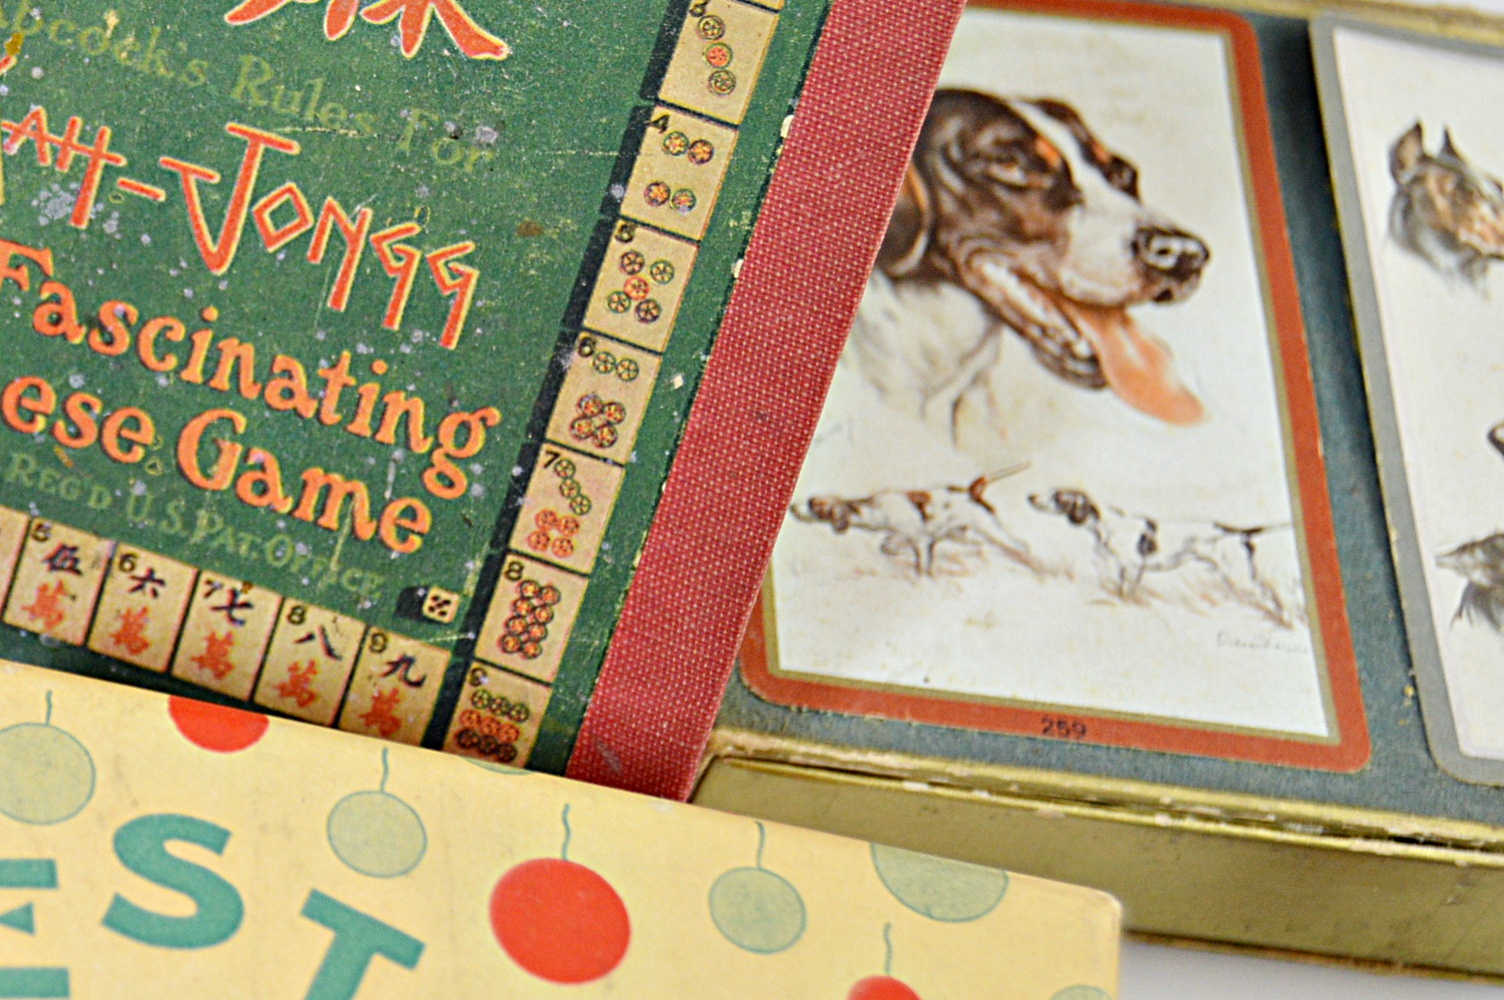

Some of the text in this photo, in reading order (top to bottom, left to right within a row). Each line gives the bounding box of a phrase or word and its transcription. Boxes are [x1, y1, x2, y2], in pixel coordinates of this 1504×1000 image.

[231, 54, 380, 140] Rules
[396, 107, 494, 174] For
[646, 114, 669, 134] 4
[577, 335, 596, 358] 6
[540, 451, 561, 469] 7
[177, 407, 434, 555] Game
[31, 523, 51, 542] 5
[117, 553, 136, 573] 6
[504, 562, 524, 581] 8
[203, 579, 222, 598] 7
[287, 605, 307, 625] 8
[369, 631, 388, 654] 9
[1040, 717, 1088, 739] 259
